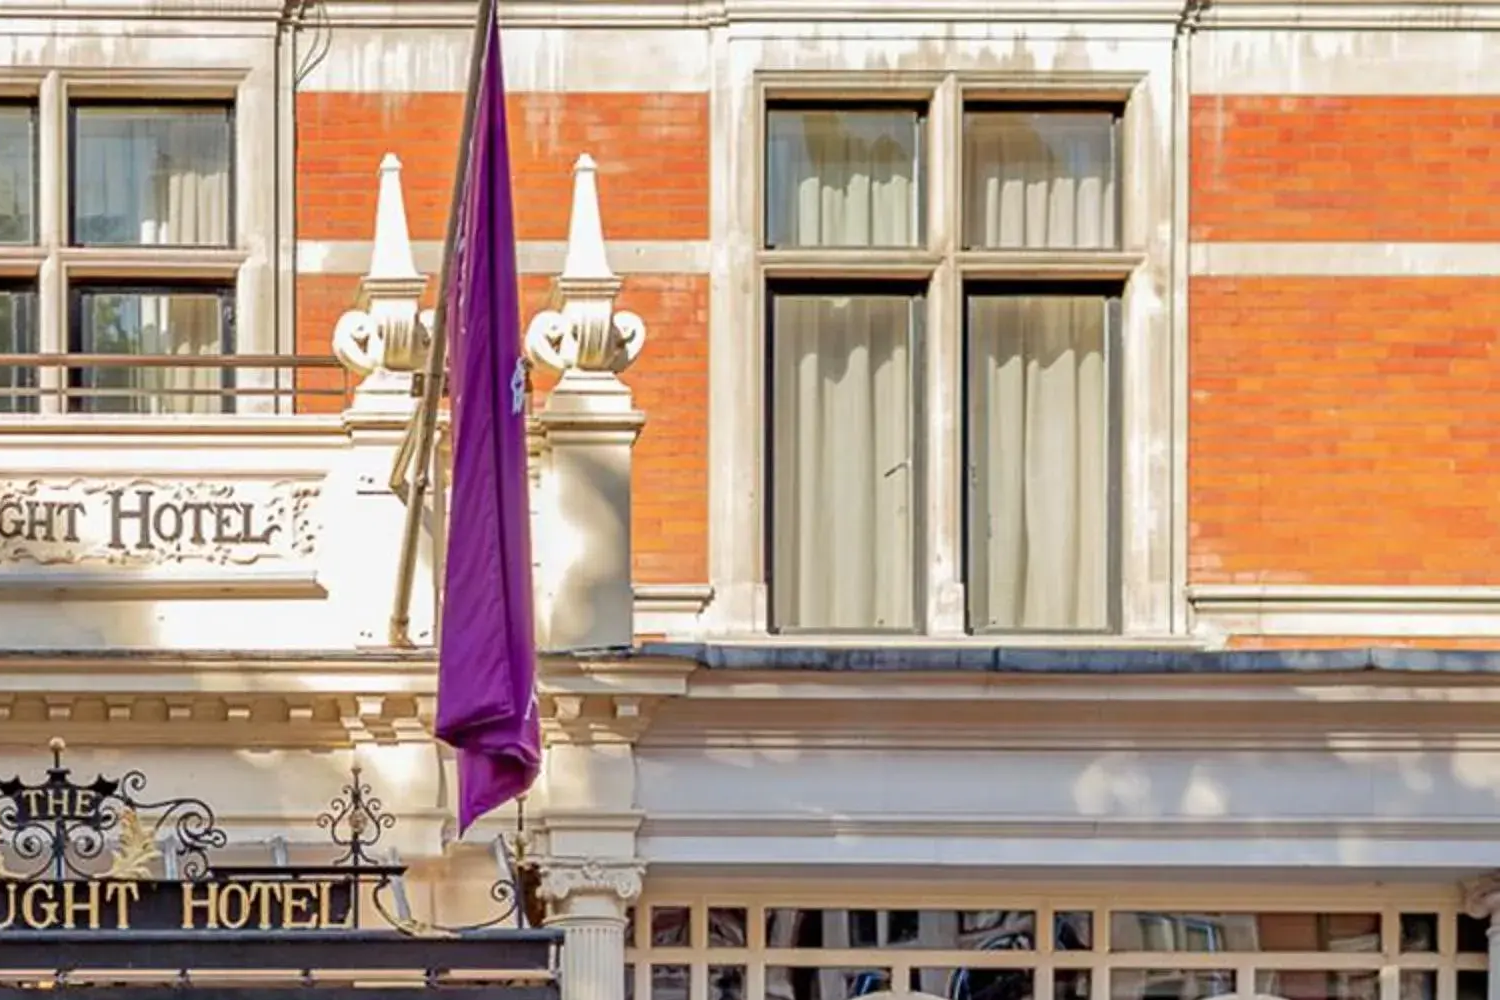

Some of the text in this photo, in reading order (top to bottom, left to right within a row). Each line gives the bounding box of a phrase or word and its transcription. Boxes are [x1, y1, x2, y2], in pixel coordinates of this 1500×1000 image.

[107, 489, 283, 550] HOTEL
[21, 787, 97, 818] THE
[182, 881, 355, 931] HOTEL
